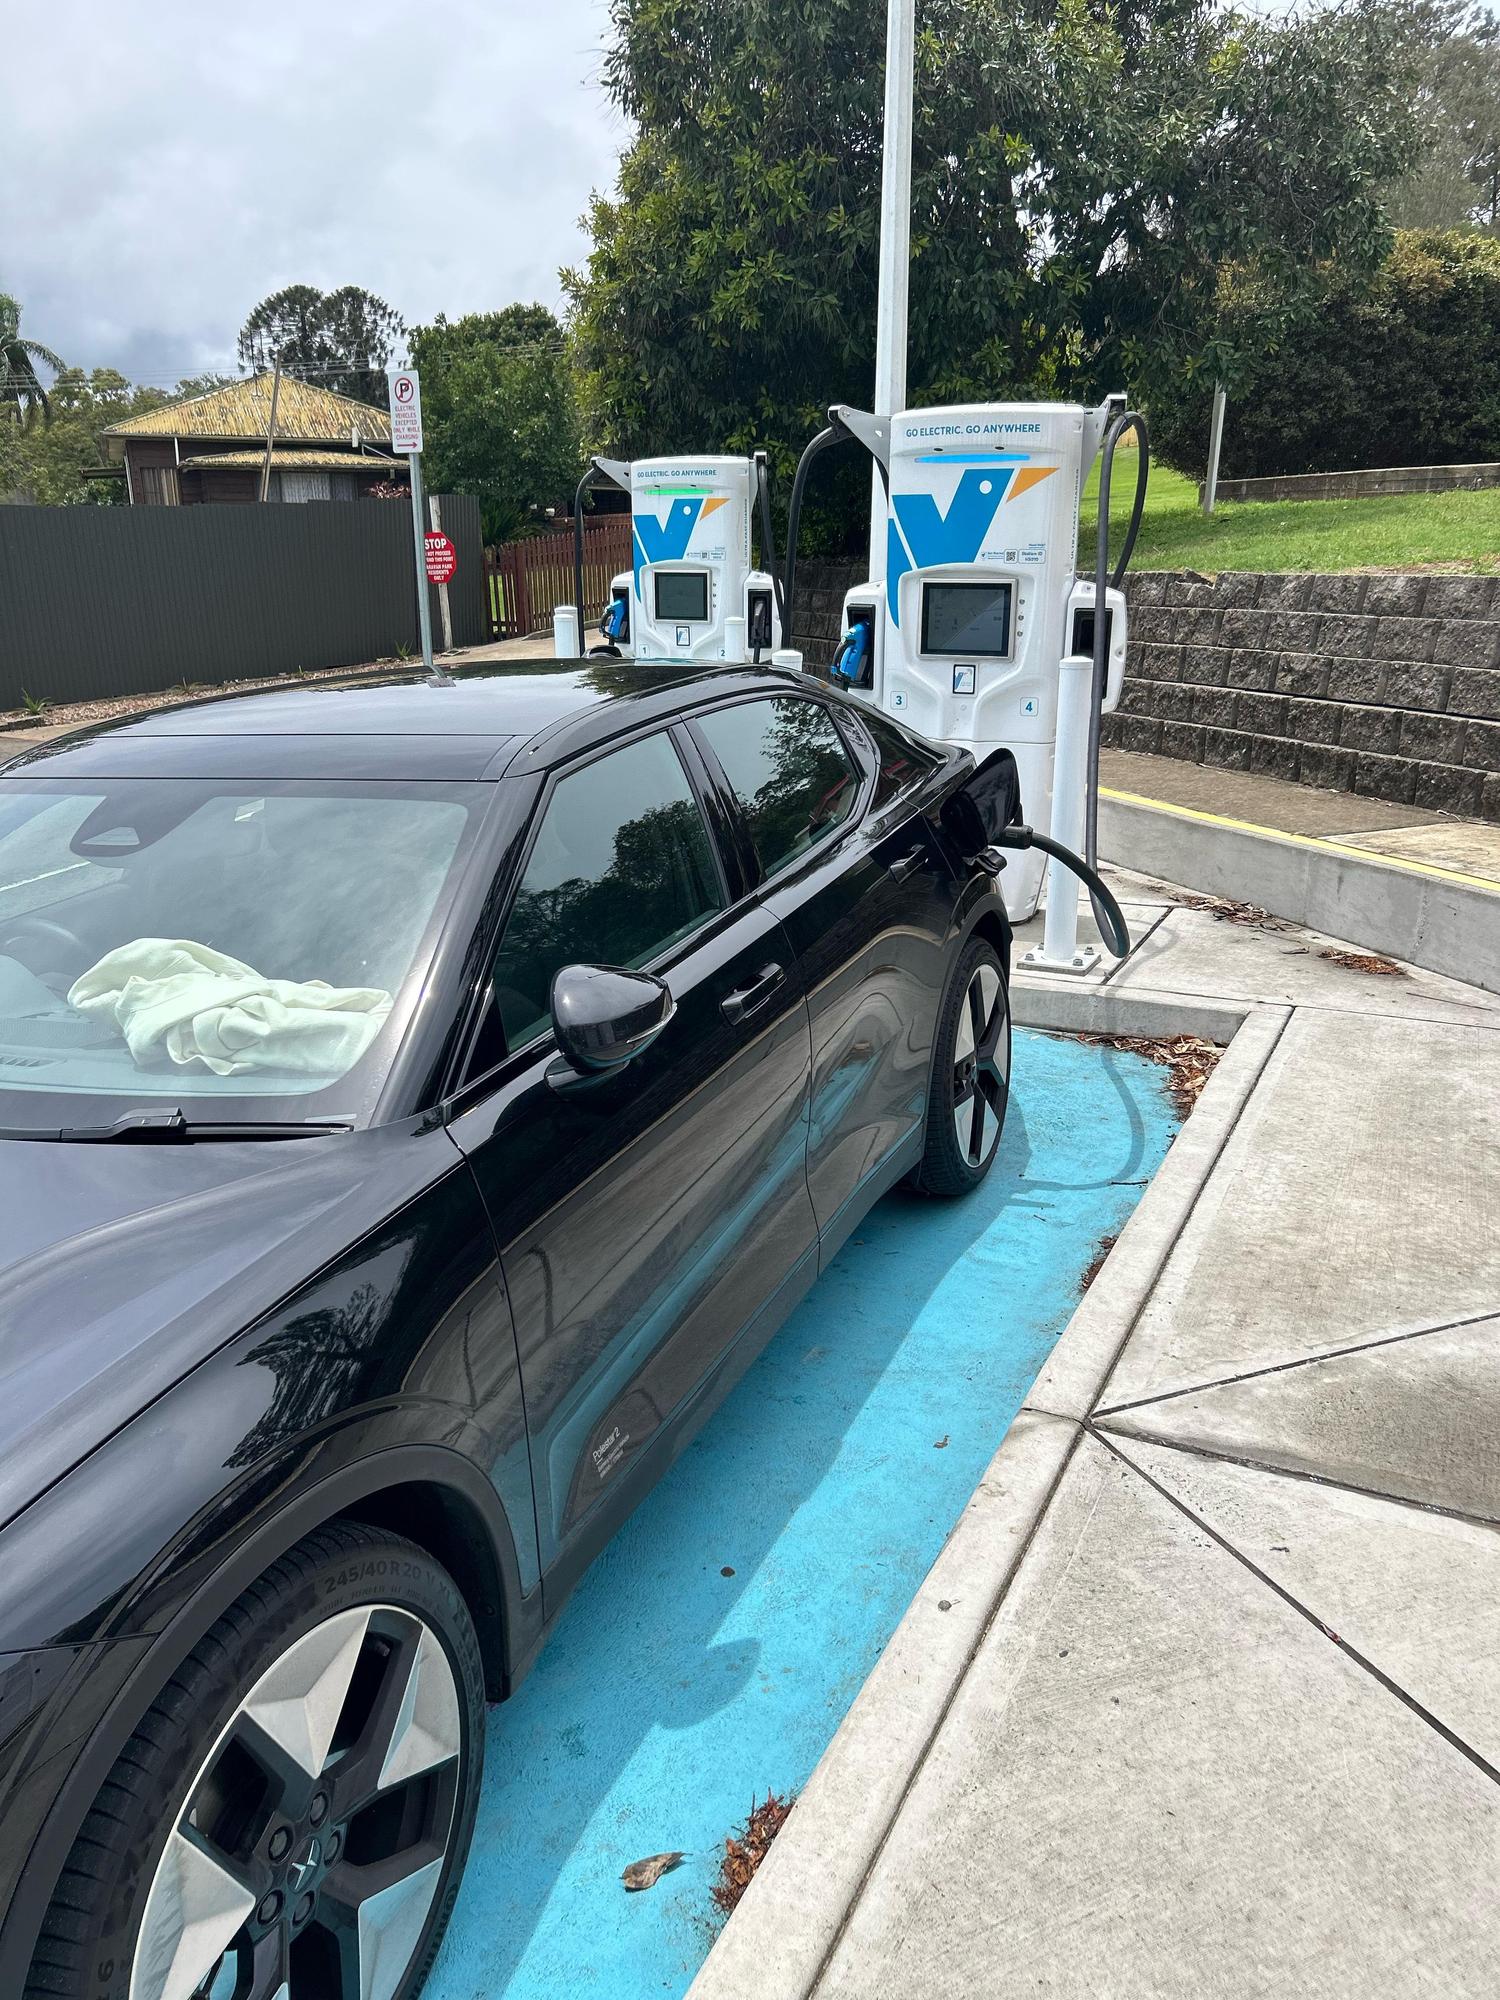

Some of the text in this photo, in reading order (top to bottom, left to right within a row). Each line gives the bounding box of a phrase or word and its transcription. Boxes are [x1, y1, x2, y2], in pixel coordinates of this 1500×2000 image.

[906, 423, 1041, 438] GO ELECTRIC. GO ANYWHERE
[681, 469, 718, 477] ANYWHERE
[424, 538, 447, 549] STOP
[720, 649, 726, 657] 2
[895, 695, 903, 706] 3
[1025, 701, 1033, 712] 4
[592, 1432, 616, 1462] Polestar
